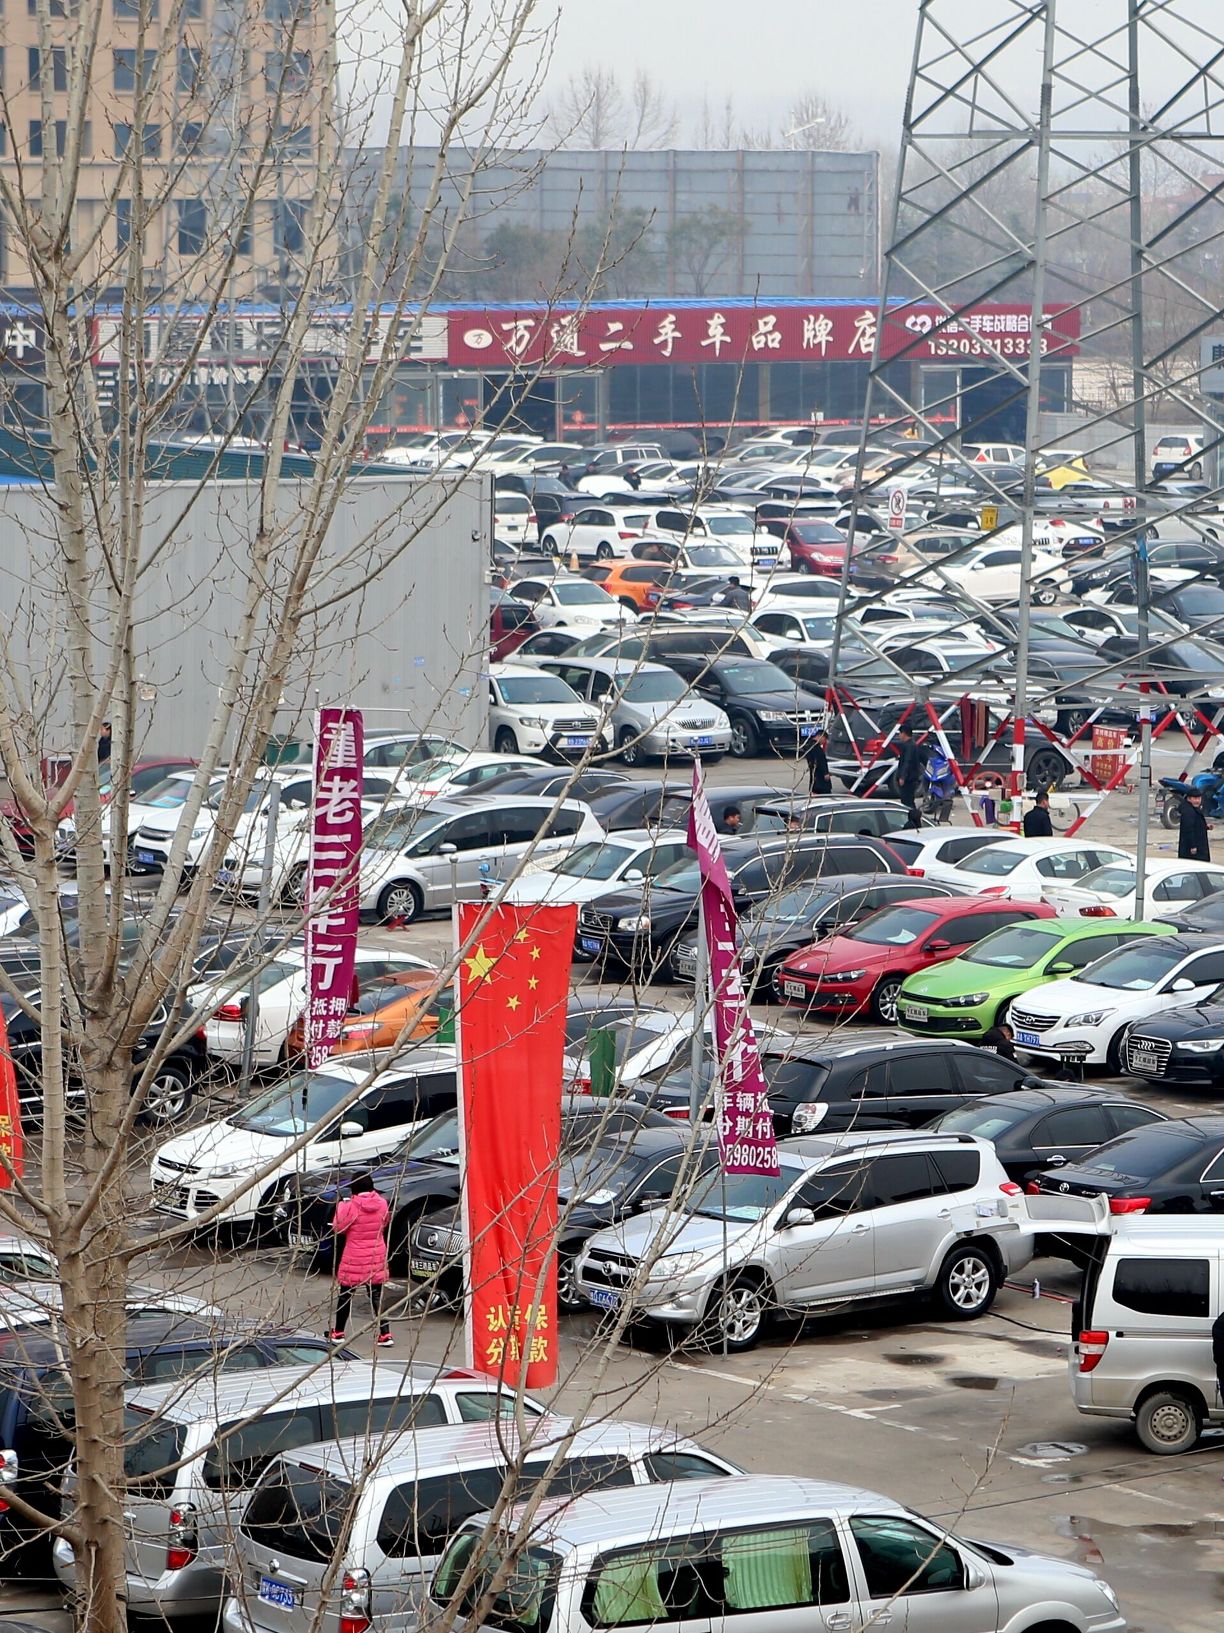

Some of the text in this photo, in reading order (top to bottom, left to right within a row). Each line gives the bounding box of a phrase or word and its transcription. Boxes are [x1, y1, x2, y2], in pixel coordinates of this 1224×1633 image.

[501, 311, 882, 358] 万通二手车品牌店
[311, 997, 347, 1017] 抵押
[311, 1018, 342, 1039] 付款
